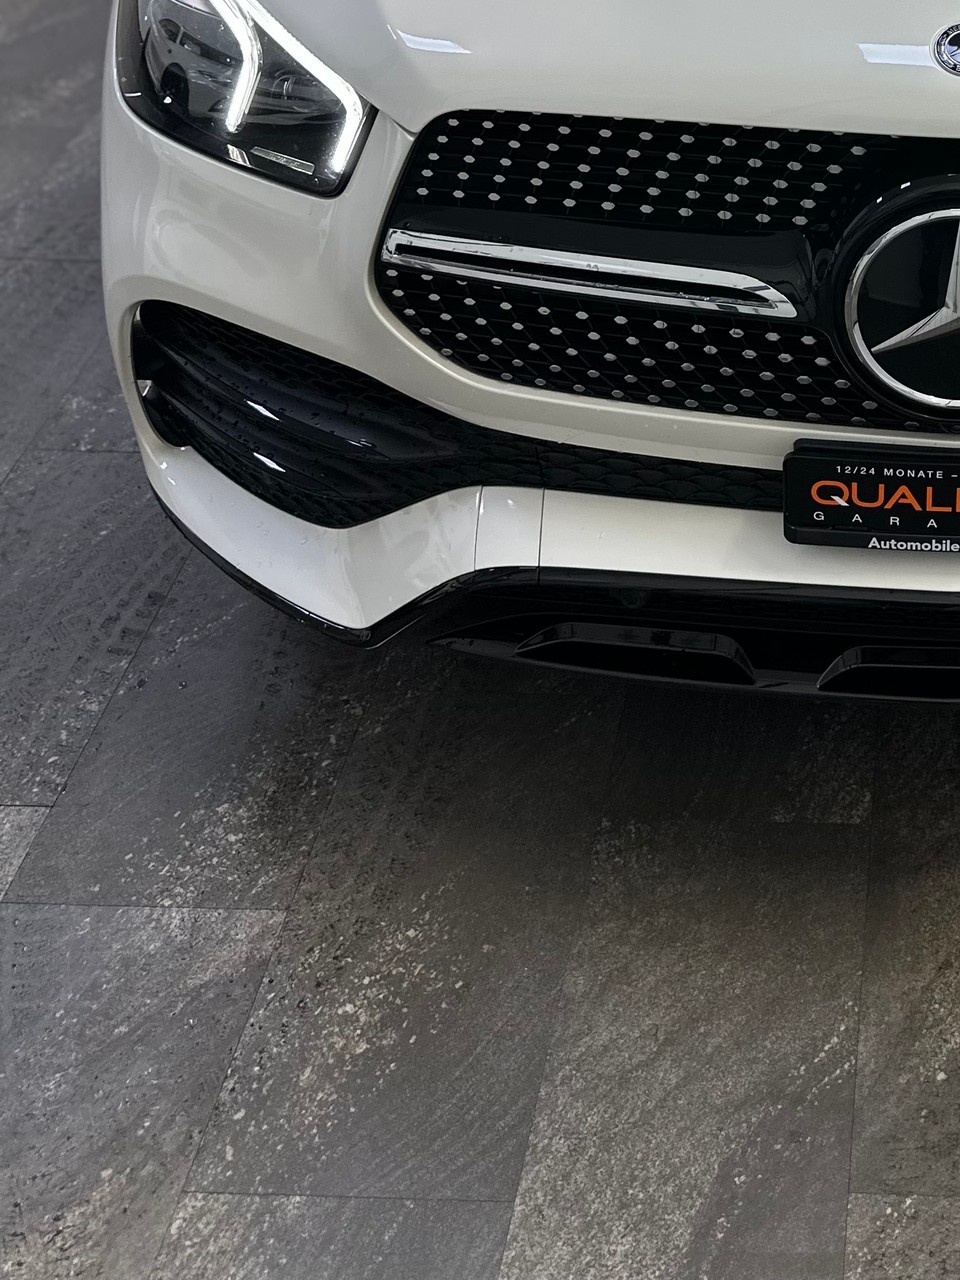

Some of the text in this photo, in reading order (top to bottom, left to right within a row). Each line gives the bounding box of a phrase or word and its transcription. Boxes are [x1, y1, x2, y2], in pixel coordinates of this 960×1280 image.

[836, 465, 876, 475] 12/24
[883, 468, 944, 479] MONATE
[868, 537, 960, 552] Automobile
